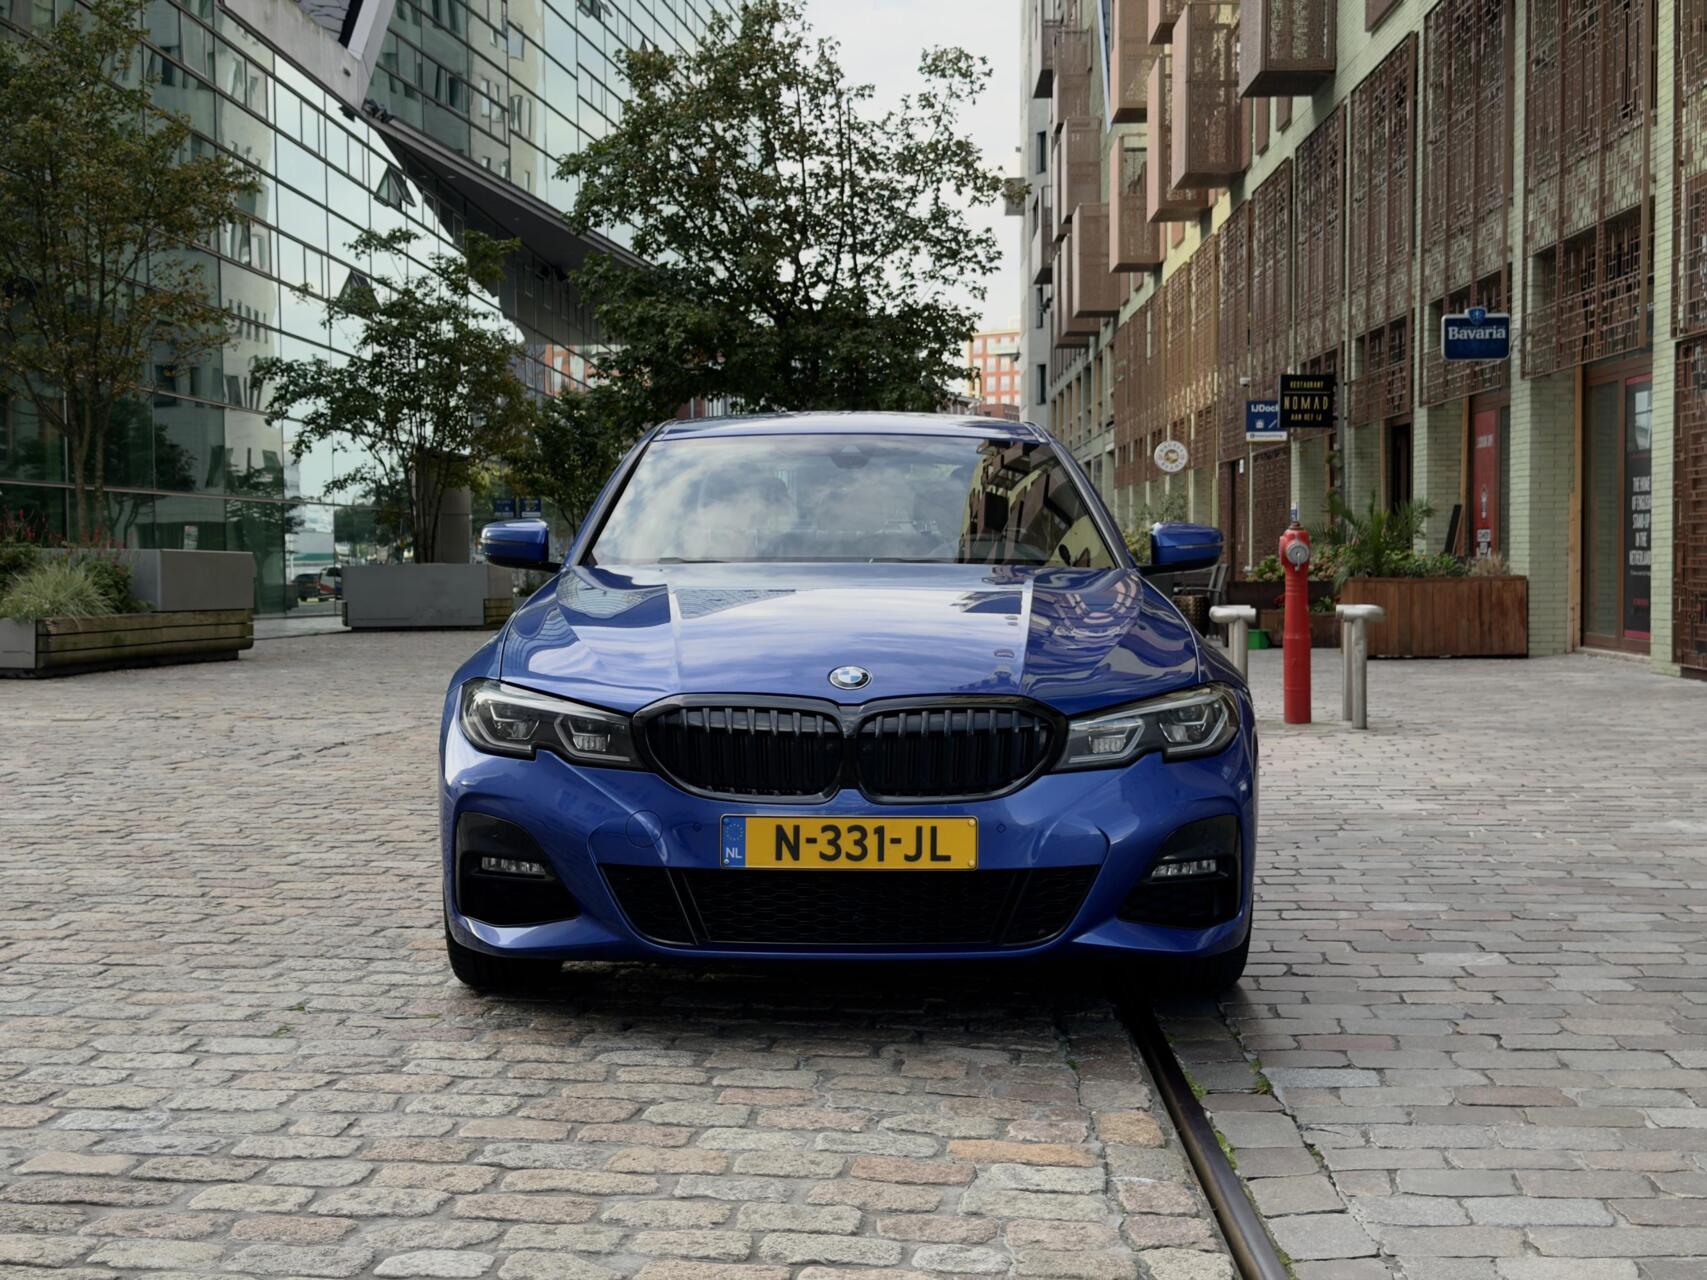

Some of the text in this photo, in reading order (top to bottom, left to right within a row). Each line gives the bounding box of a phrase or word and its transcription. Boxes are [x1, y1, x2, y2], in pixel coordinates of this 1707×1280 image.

[1448, 326, 1506, 340] Bavaria
[1290, 380, 1324, 389] RESTAURANT
[1283, 396, 1329, 410] NOMAD
[1629, 550, 1652, 566] NETHERLAND
[774, 824, 952, 863] N-331-JL
[725, 847, 743, 860] NL
